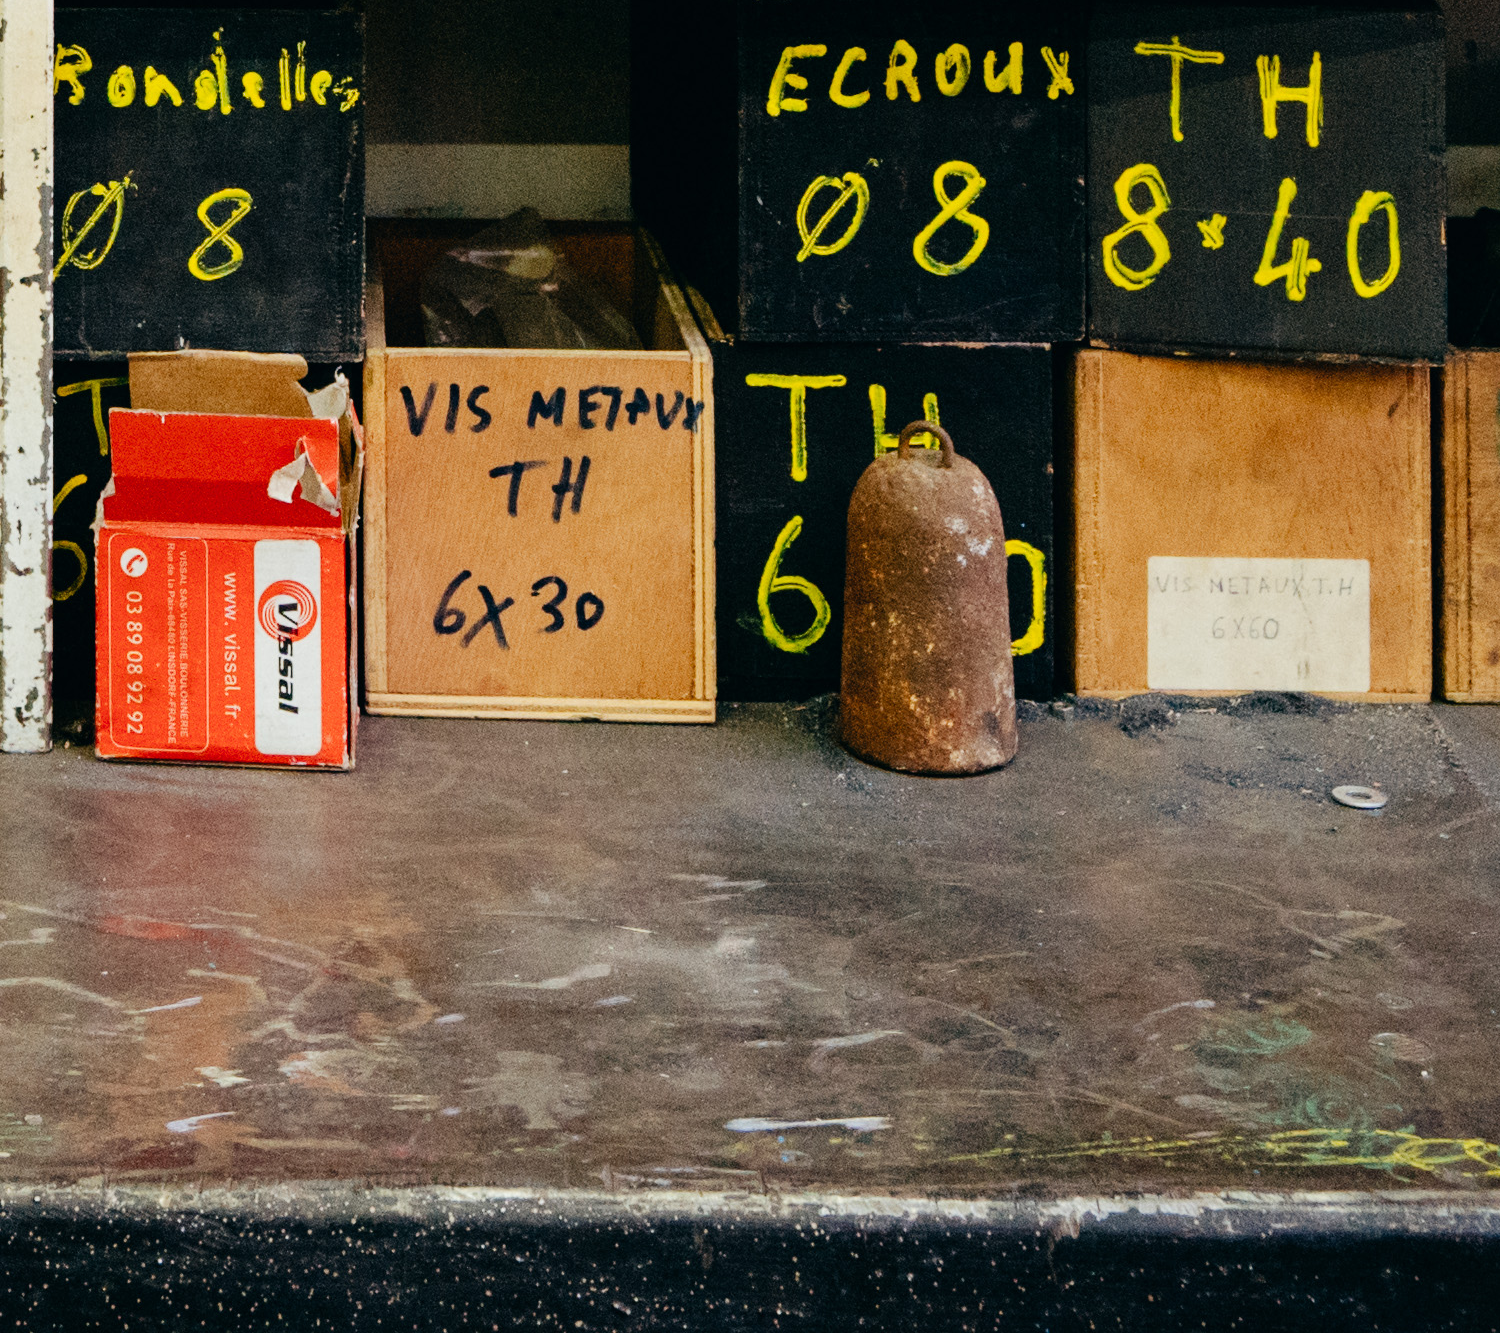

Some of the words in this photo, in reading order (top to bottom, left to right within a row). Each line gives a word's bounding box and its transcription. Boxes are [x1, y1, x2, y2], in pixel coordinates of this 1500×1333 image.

[400, 382, 493, 438] VIS
[180, 551, 188, 585] VISSAL
[126, 591, 142, 615] 03
[127, 621, 143, 645] 89
[127, 651, 143, 675] 08
[278, 602, 299, 714] Vissal
[127, 682, 143, 705] 92
[127, 711, 144, 735] 92
